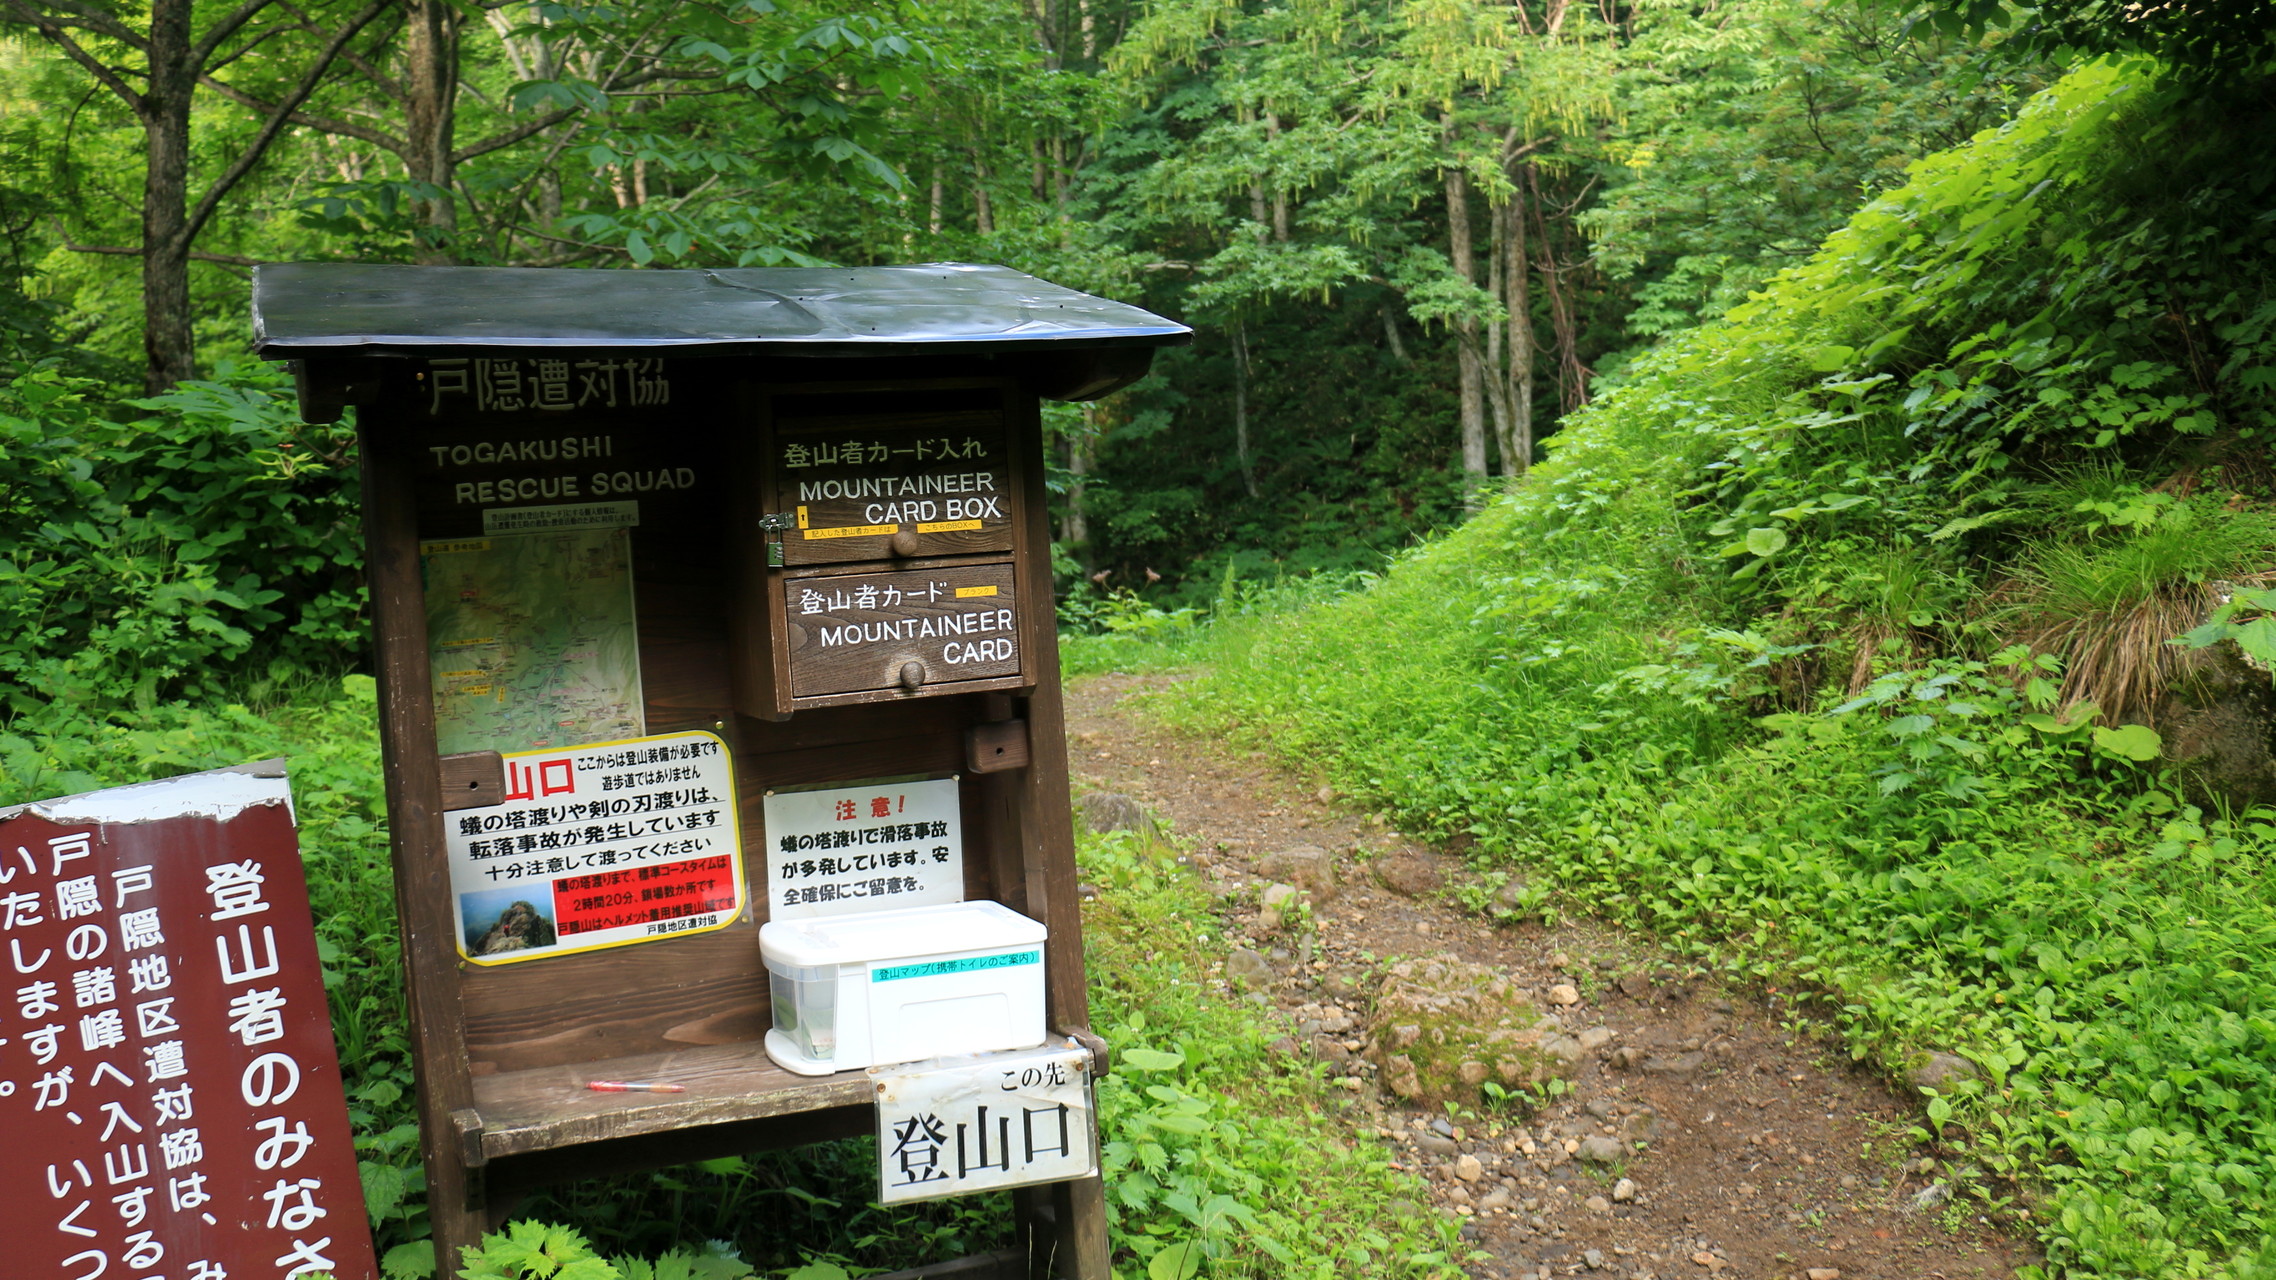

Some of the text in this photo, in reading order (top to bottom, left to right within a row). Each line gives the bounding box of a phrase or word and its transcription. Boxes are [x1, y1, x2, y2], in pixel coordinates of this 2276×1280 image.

[428, 358, 670, 415] 戸隠遭対協
[429, 436, 612, 467] TOGAKUSHI
[784, 437, 988, 468] 登山者カード入れ
[456, 468, 695, 504] RESCUE SQUAD
[800, 472, 995, 502] MOUNTAINEER
[865, 496, 1002, 525] CARD BOX
[811, 525, 892, 538] 記入した登山者カードは
[924, 521, 976, 532] こちらのBOXへ
[799, 581, 948, 615] 登山者カード
[820, 609, 1013, 647] MOUNTAINEER
[943, 638, 1013, 664] CARD
[577, 741, 719, 771] ここからは登山装備が必要です
[602, 765, 701, 791] 遊歩道ではありません
[460, 787, 719, 835] 蟻の塔渡りや剣の刃渡りは、
[469, 809, 720, 859] 転落事故が発生しています
[780, 821, 948, 853] 蟻の塔渡りで滑落事故
[485, 838, 711, 881] 十分注意して渡ってください
[782, 846, 949, 879] が多発しています。安
[783, 876, 925, 906] 全確保にご留意を。
[647, 915, 718, 935] 戸隠地区遭対協
[47, 832, 166, 1280] 戸隠の諸峰へ入山する
[1001, 1062, 1066, 1092] この先
[891, 1102, 1070, 1188] 登山口
